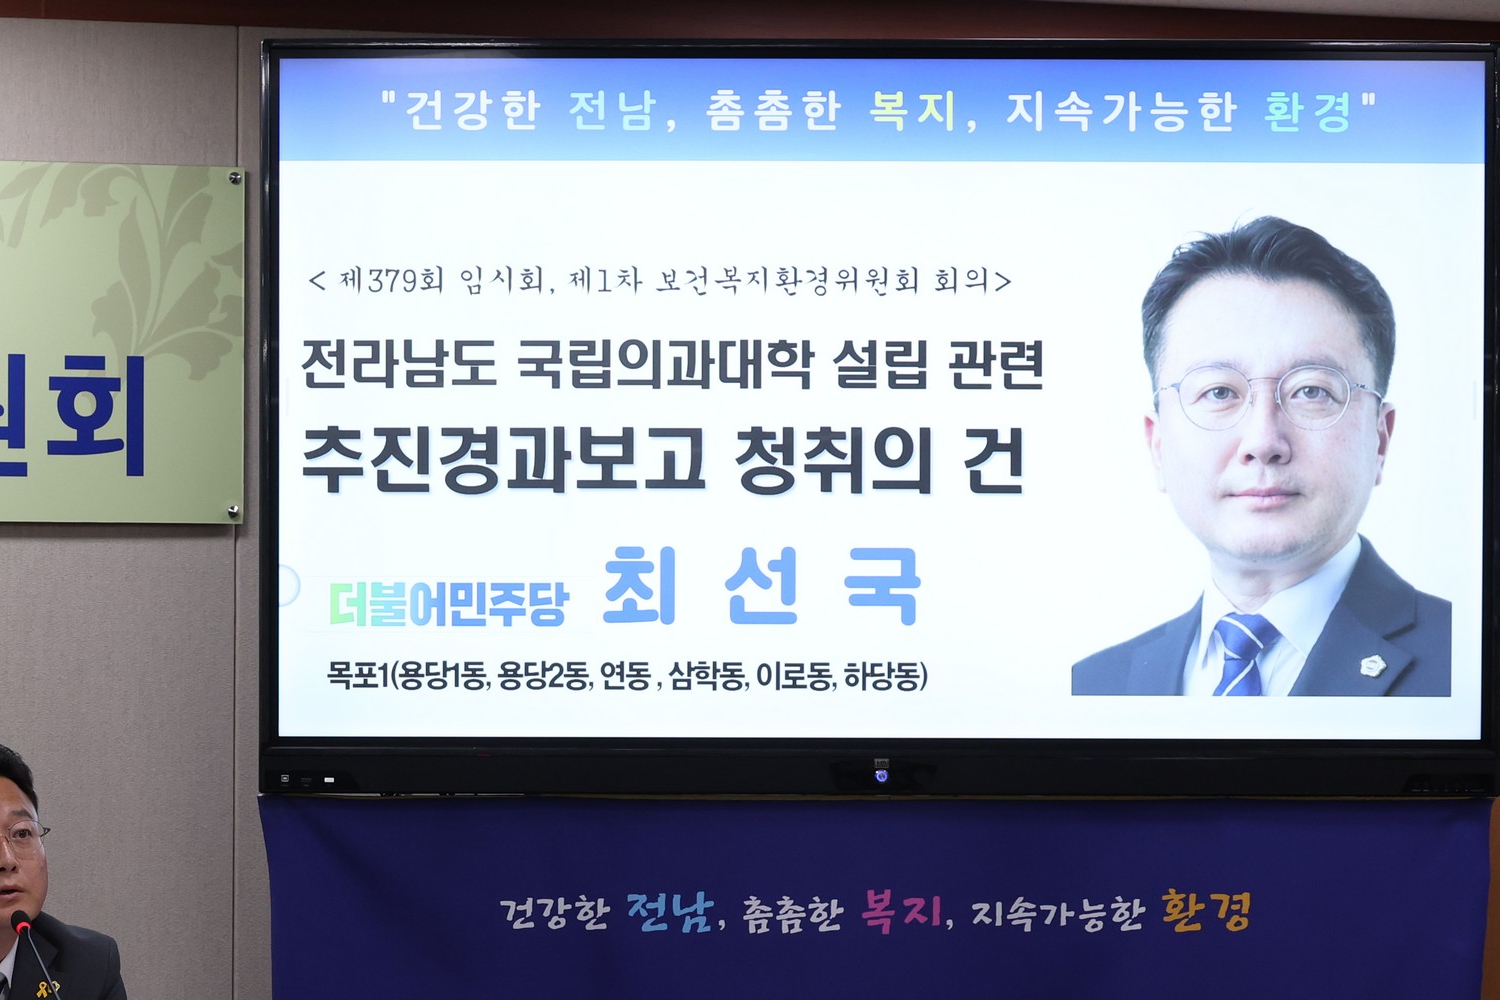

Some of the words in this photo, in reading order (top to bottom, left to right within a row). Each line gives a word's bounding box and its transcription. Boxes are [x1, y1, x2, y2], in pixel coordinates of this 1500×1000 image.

[382, 89, 541, 131] "건강한
[569, 89, 676, 133] 전남,
[706, 89, 842, 131] 촘촘한
[869, 90, 976, 133] 복지,
[1007, 91, 1238, 132] 지속가능한
[1264, 91, 1376, 133] 환경"
[340, 265, 443, 294] 제379회
[460, 265, 555, 296] 임시회,
[568, 265, 643, 293] 제1차
[656, 265, 918, 297] 보건복지환경위원회
[301, 338, 497, 389] 전라남도
[517, 338, 816, 390] 국립의과대학
[832, 339, 927, 390] 설립
[948, 340, 1043, 390] 관련
[302, 425, 706, 495] 추진경과보고
[735, 426, 932, 496] 청취의
[964, 427, 1023, 495] 건
[329, 581, 571, 627] 더불어민주당
[326, 660, 492, 691] 목포1(용당1동,
[497, 660, 594, 691] 용당2동,
[668, 660, 750, 692] 삼학동,
[756, 661, 838, 692] 이로동,
[843, 661, 928, 692] 하당동)
[499, 894, 611, 931] 건강한
[627, 891, 726, 934] 전남,
[742, 895, 845, 935] 촘촘한
[861, 888, 954, 935] 복지,
[971, 895, 1147, 933] 지속가능한
[1161, 887, 1251, 933] 환경
